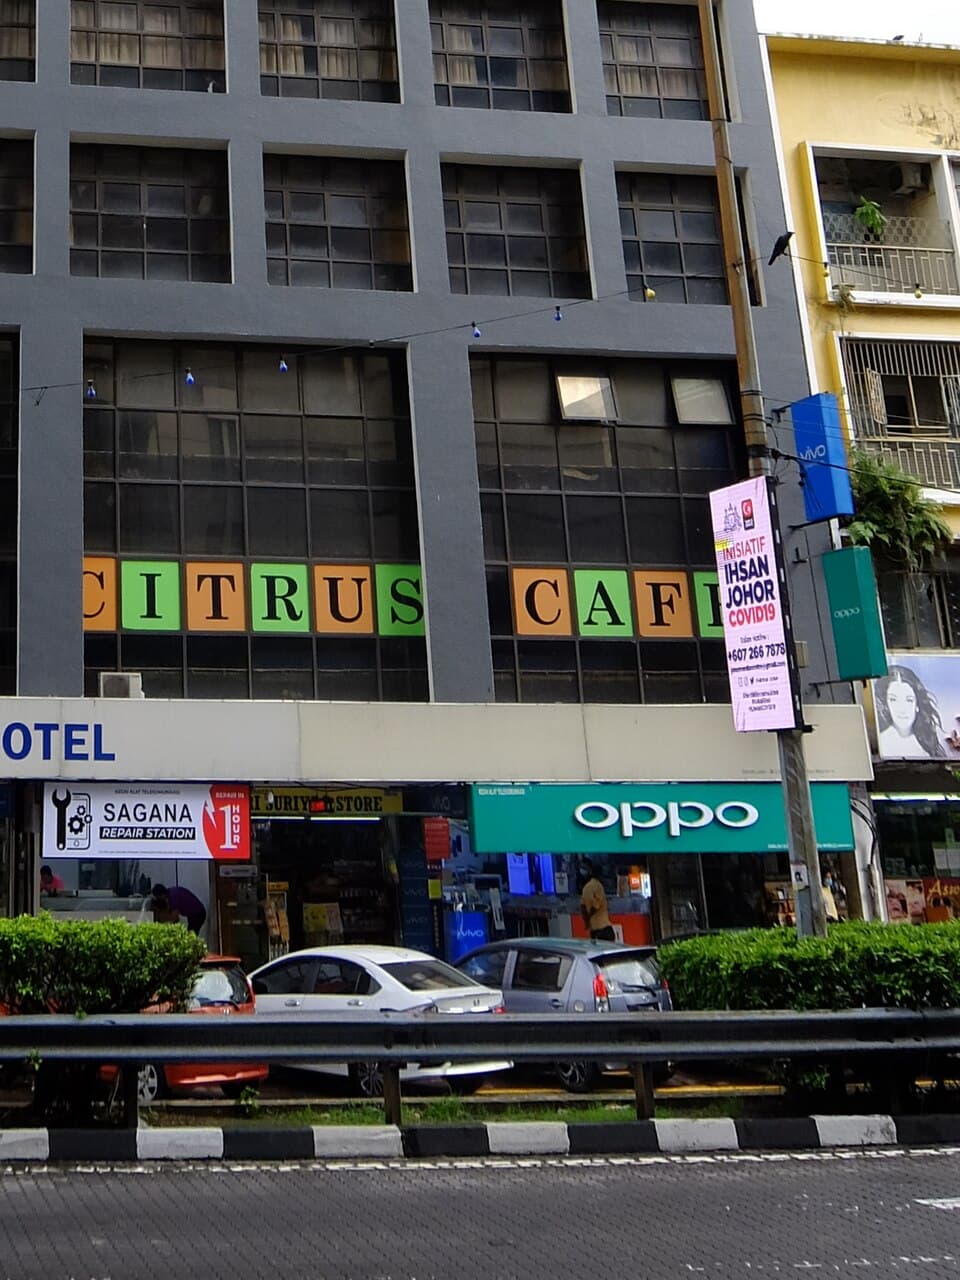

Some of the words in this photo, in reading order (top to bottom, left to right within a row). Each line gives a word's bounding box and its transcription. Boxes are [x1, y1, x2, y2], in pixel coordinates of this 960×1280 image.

[722, 536, 766, 561] INISIATIF
[724, 554, 770, 585] IHSAN
[83, 571, 424, 625] CITRUS
[726, 579, 776, 609] JOHOR
[728, 603, 776, 628] COVID19
[749, 645, 765, 660] 266
[765, 642, 786, 657] 7878
[103, 803, 193, 822] SAGANA
[336, 796, 383, 811] STORE
[219, 804, 237, 849] 1
[232, 804, 240, 844] HOUR
[574, 801, 759, 837] oppo
[101, 828, 144, 839] REPAIR
[145, 828, 195, 839] STATION
